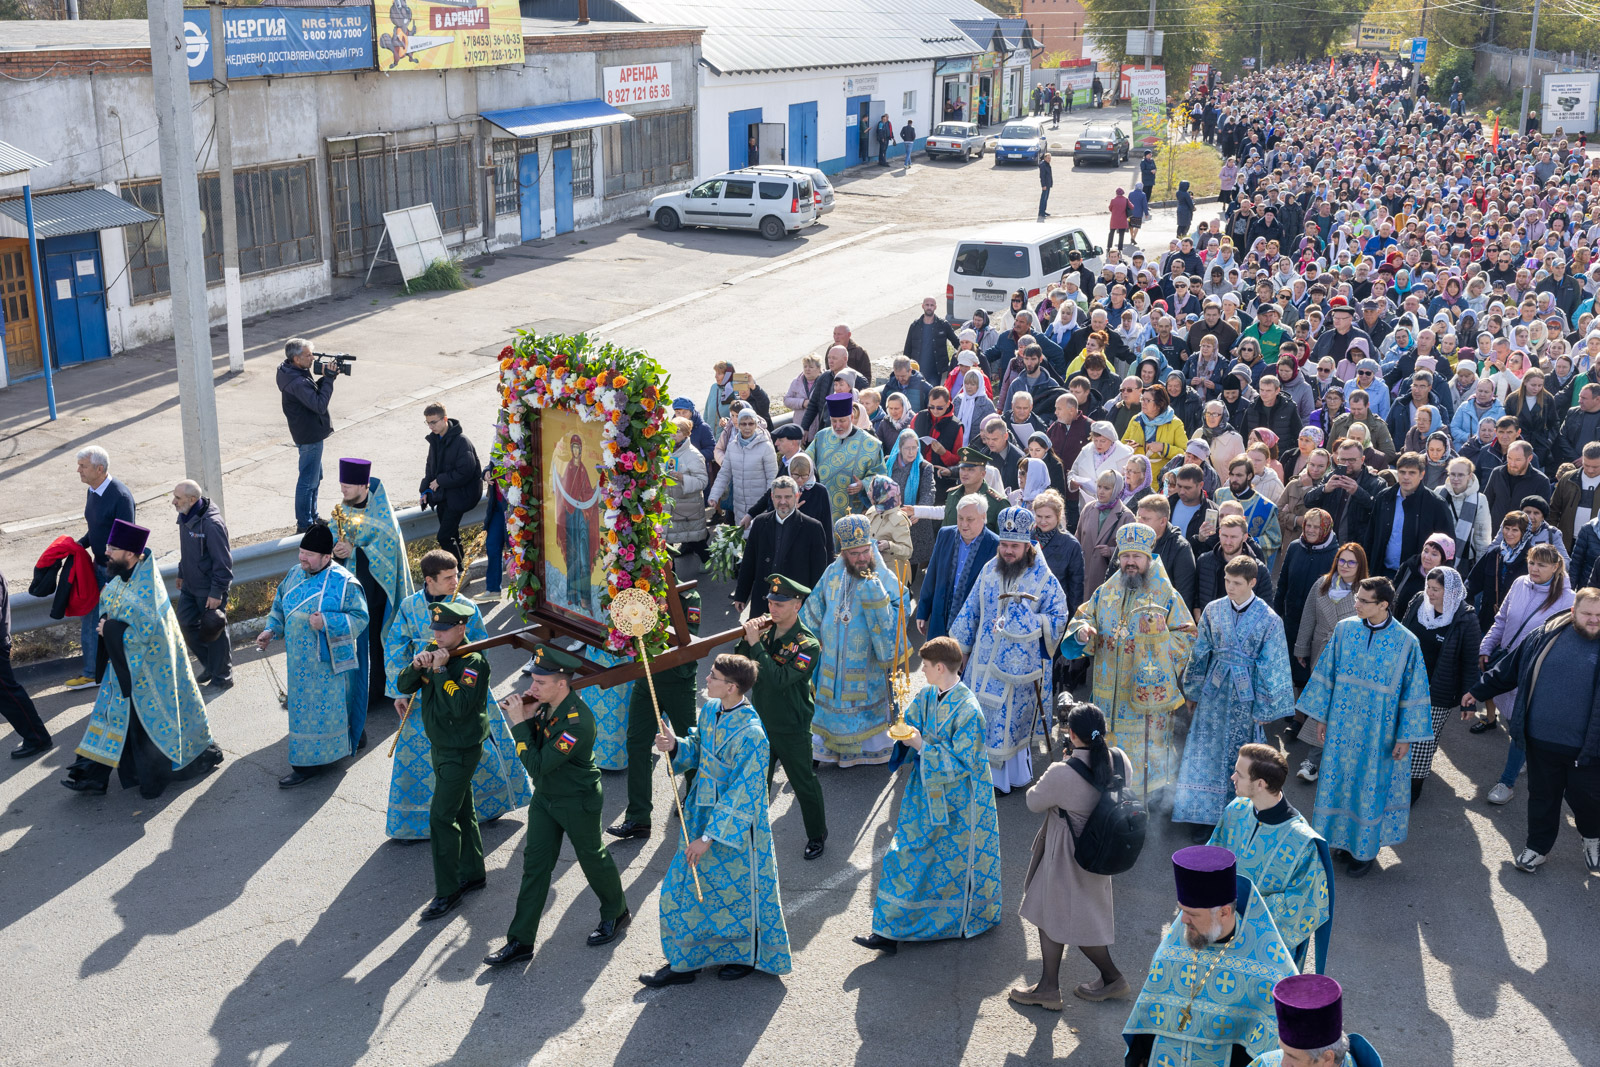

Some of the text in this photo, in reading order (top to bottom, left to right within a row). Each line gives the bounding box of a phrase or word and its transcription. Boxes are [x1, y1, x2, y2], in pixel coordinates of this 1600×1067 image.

[301, 17, 362, 29] NRG-TK.RU
[435, 8, 484, 28] В АРЕНДУ!
[222, 18, 287, 39] НЕРГИЯ
[303, 28, 362, 40] 8 800 700 7000
[493, 33, 521, 47] 56-10-35
[225, 47, 364, 66] ЖЕДНЕВНО ДОСТАВЛЯЕМ СБОРНЫЙ ГРУЗ
[619, 65, 659, 83] АРЕНДА
[607, 84, 670, 104] 8 927 121 65 36
[1137, 87, 1160, 96] МЯСО
[1138, 97, 1160, 105] РЫБА
